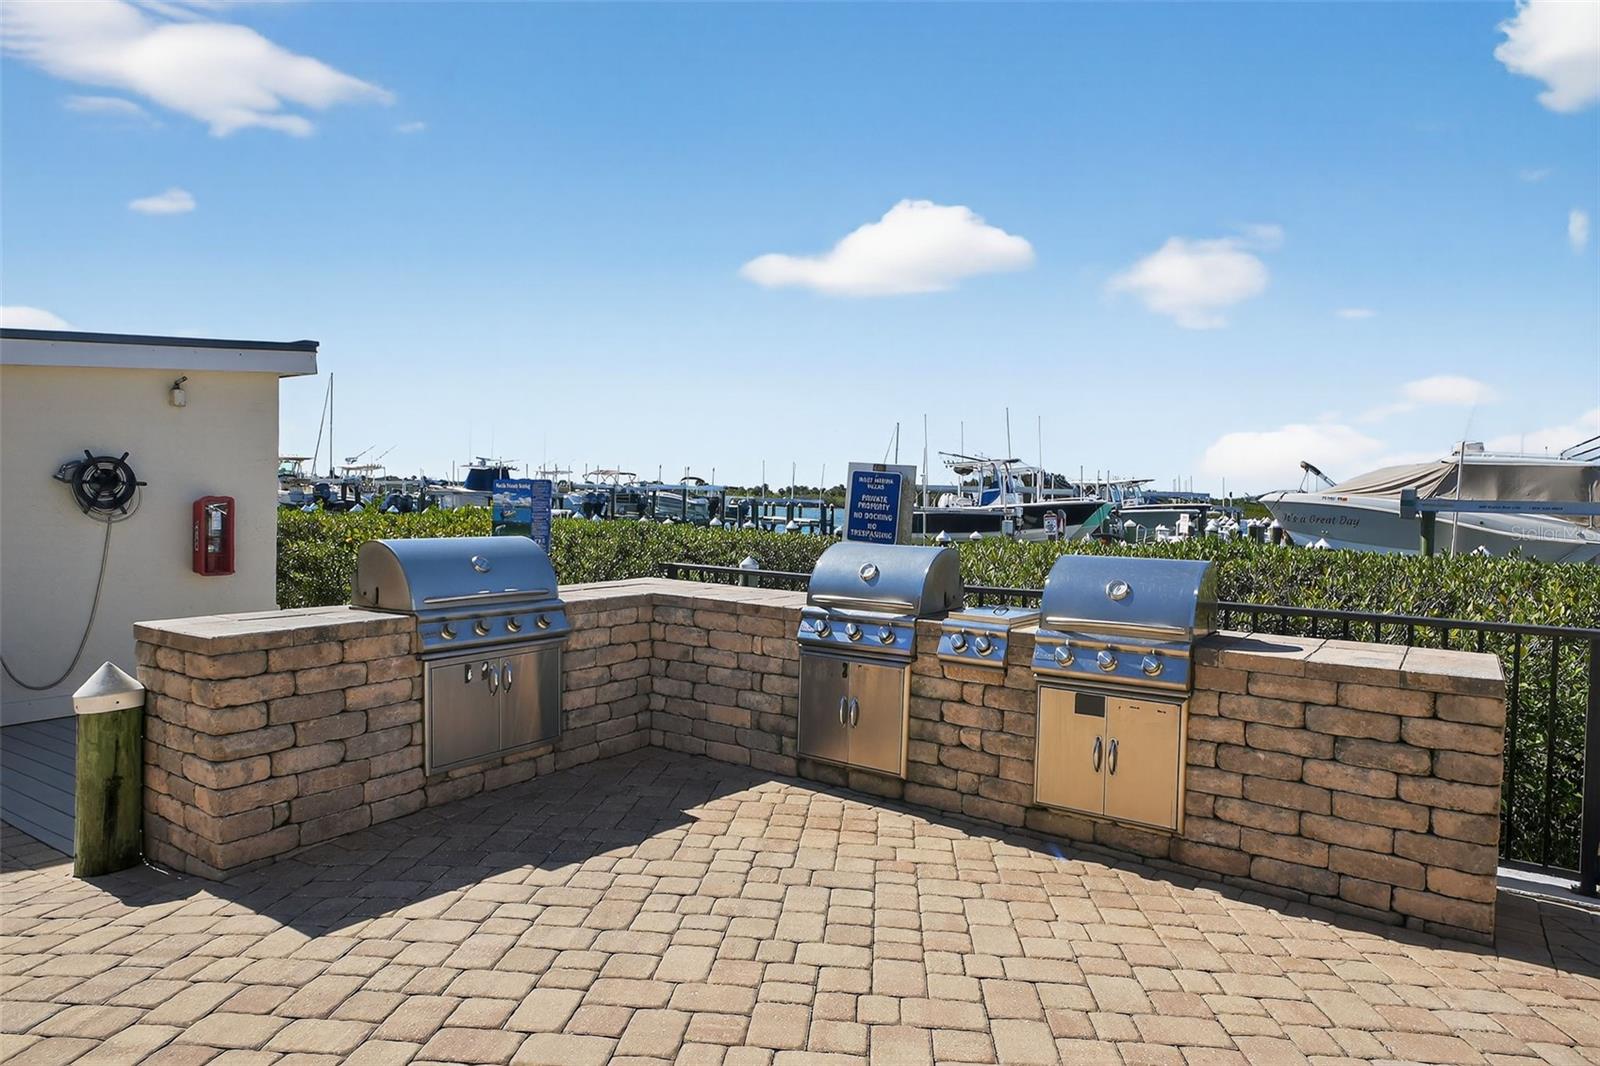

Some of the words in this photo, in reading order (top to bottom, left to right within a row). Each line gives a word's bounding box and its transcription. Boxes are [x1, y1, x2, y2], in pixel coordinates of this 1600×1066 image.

[861, 494, 888, 503] PRIVATE
[857, 502, 890, 511] PROPERTY
[864, 512, 893, 521] DOCKING
[1283, 512, 1297, 523] It's
[1309, 515, 1336, 525] Great
[1339, 515, 1360, 528] Day
[850, 528, 893, 539] TRESPASSING
